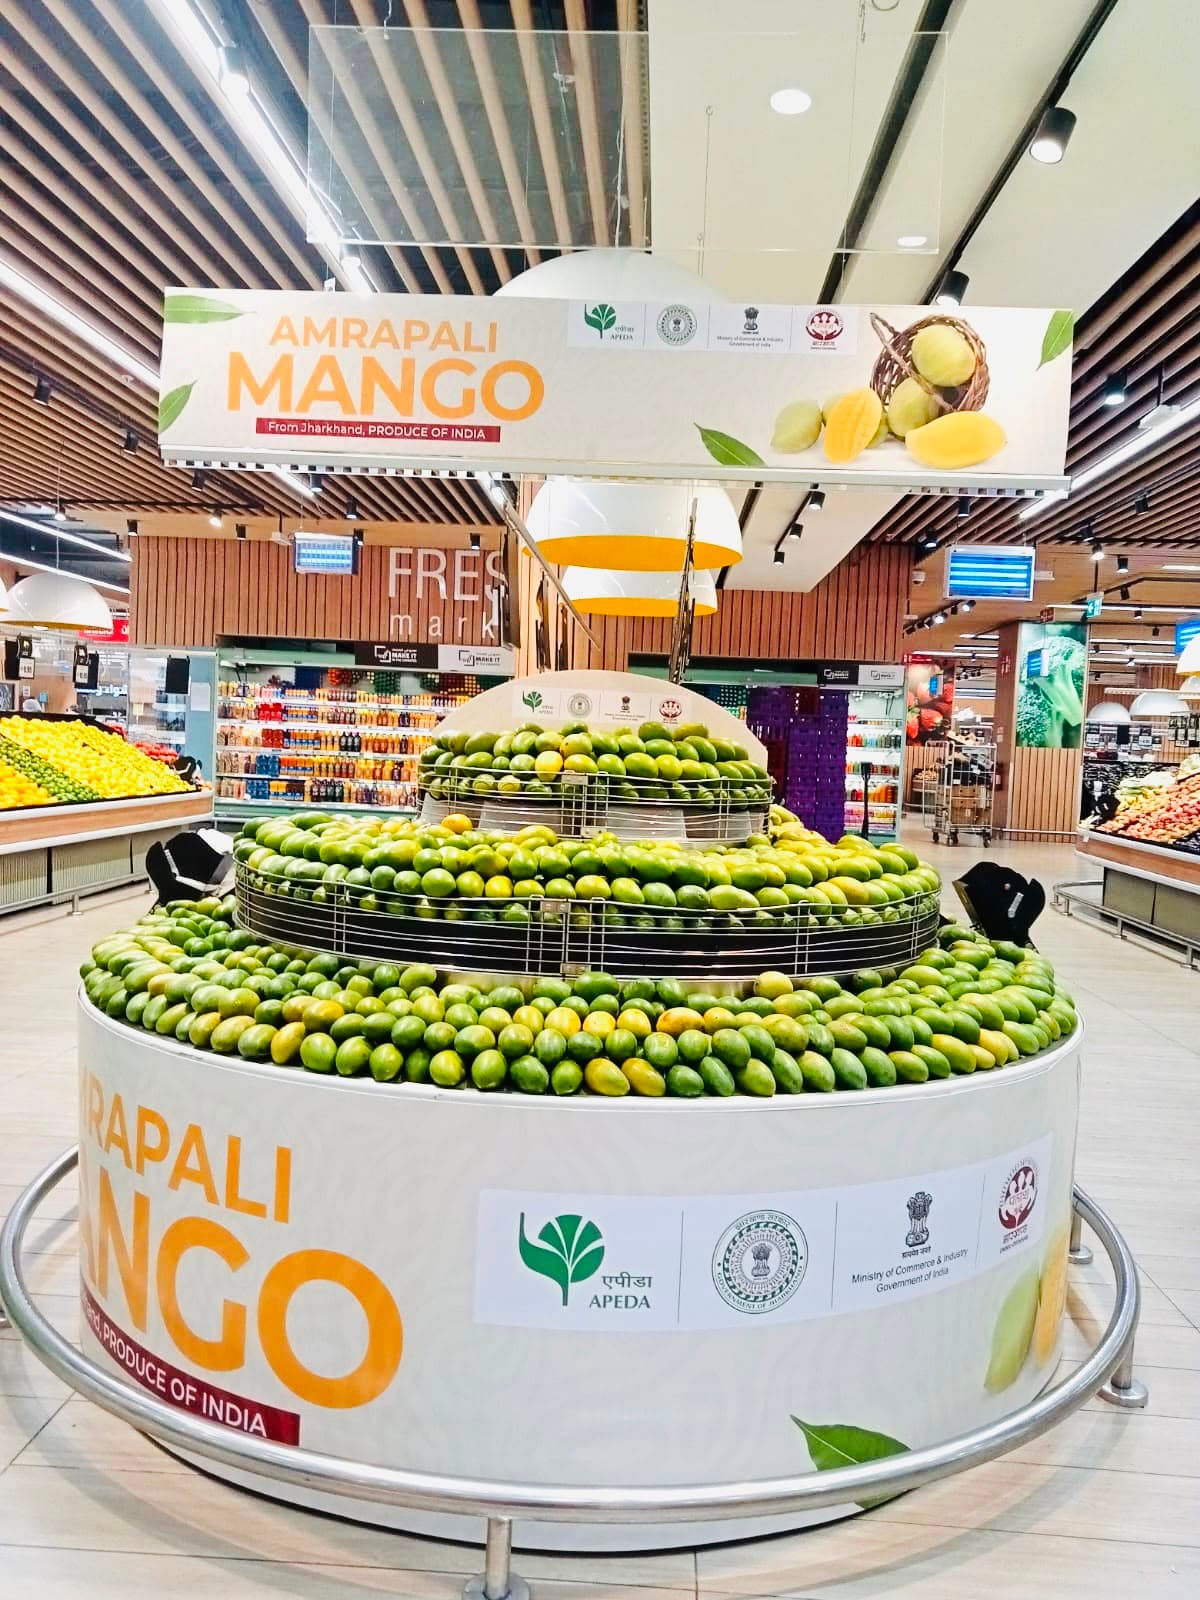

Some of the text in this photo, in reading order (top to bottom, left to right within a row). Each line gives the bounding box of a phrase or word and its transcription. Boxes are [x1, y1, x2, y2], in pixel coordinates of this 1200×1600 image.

[268, 315, 498, 353] AMRAPALI
[226, 351, 545, 422] MANGO
[268, 421, 486, 440] From Jharkhand, PRODUCE OF INDIA
[388, 547, 506, 601] FRES
[389, 611, 495, 639] mark
[84, 1071, 292, 1224] RAPALI
[601, 1271, 653, 1290] एपीडा
[851, 1247, 969, 1284] Ministry of Commerce & Industry
[876, 1266, 949, 1294] Government of India
[84, 1164, 404, 1409] NGO
[588, 1295, 651, 1310] APEDA
[103, 1323, 167, 1393] PRODUCE
[170, 1378, 197, 1406] OF
[202, 1392, 268, 1438] INDIA
